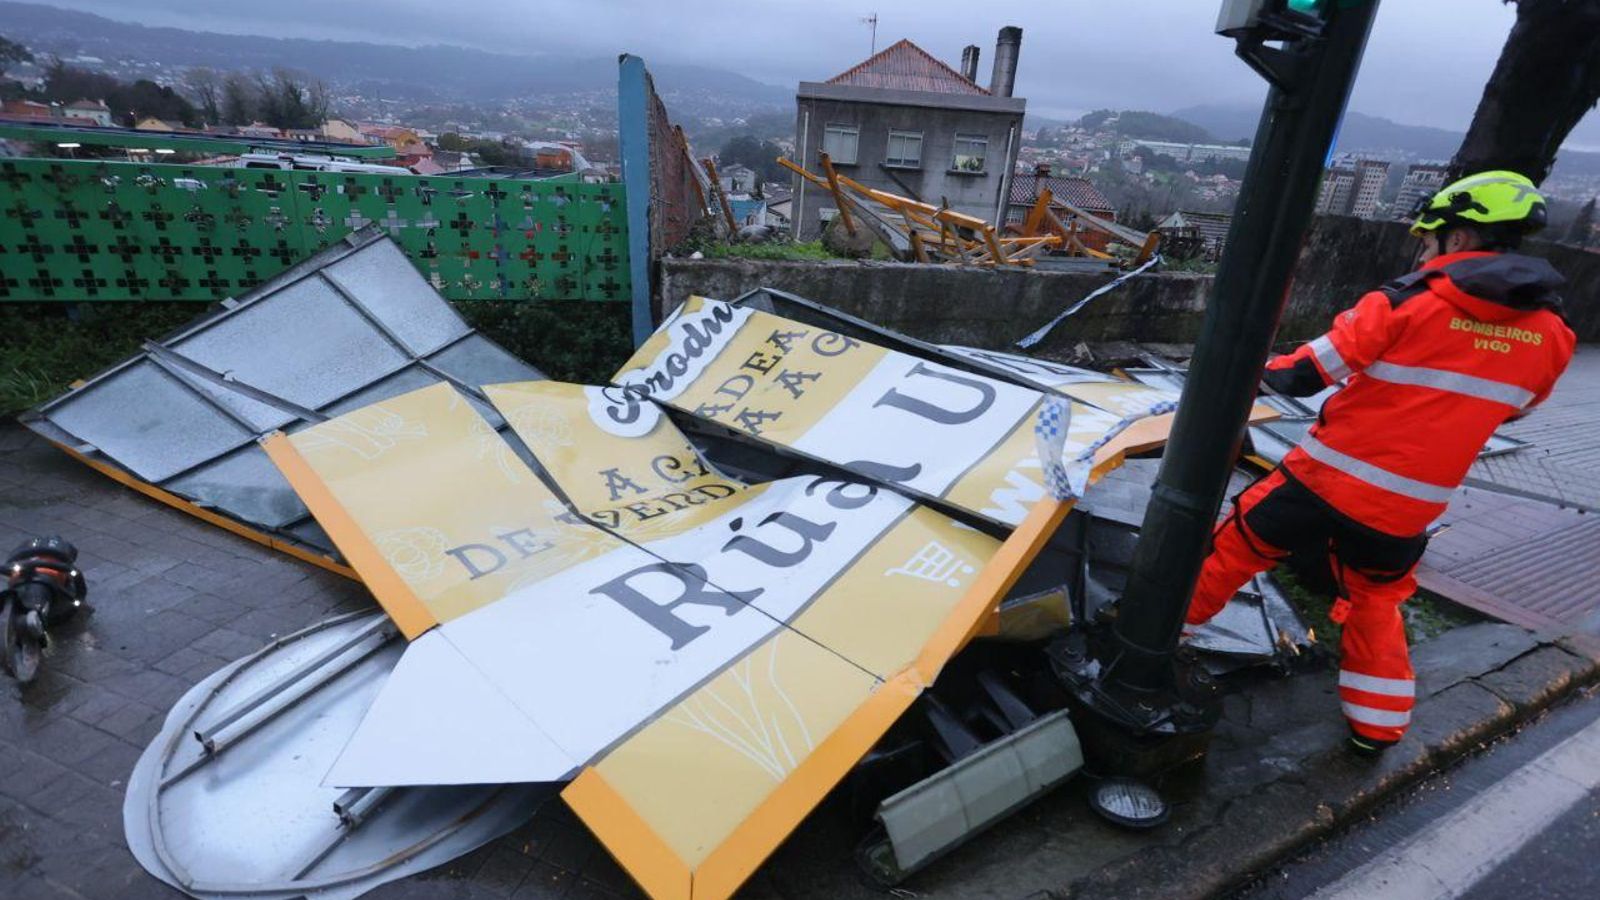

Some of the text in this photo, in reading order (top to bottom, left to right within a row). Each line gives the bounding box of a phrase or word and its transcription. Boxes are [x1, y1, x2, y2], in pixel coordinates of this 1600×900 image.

[1449, 317, 1544, 346] BOMBEIROS
[1473, 338, 1512, 353] VIGO
[602, 302, 744, 424] Produ
[445, 527, 555, 581] DE
[589, 459, 923, 652] Rúa
